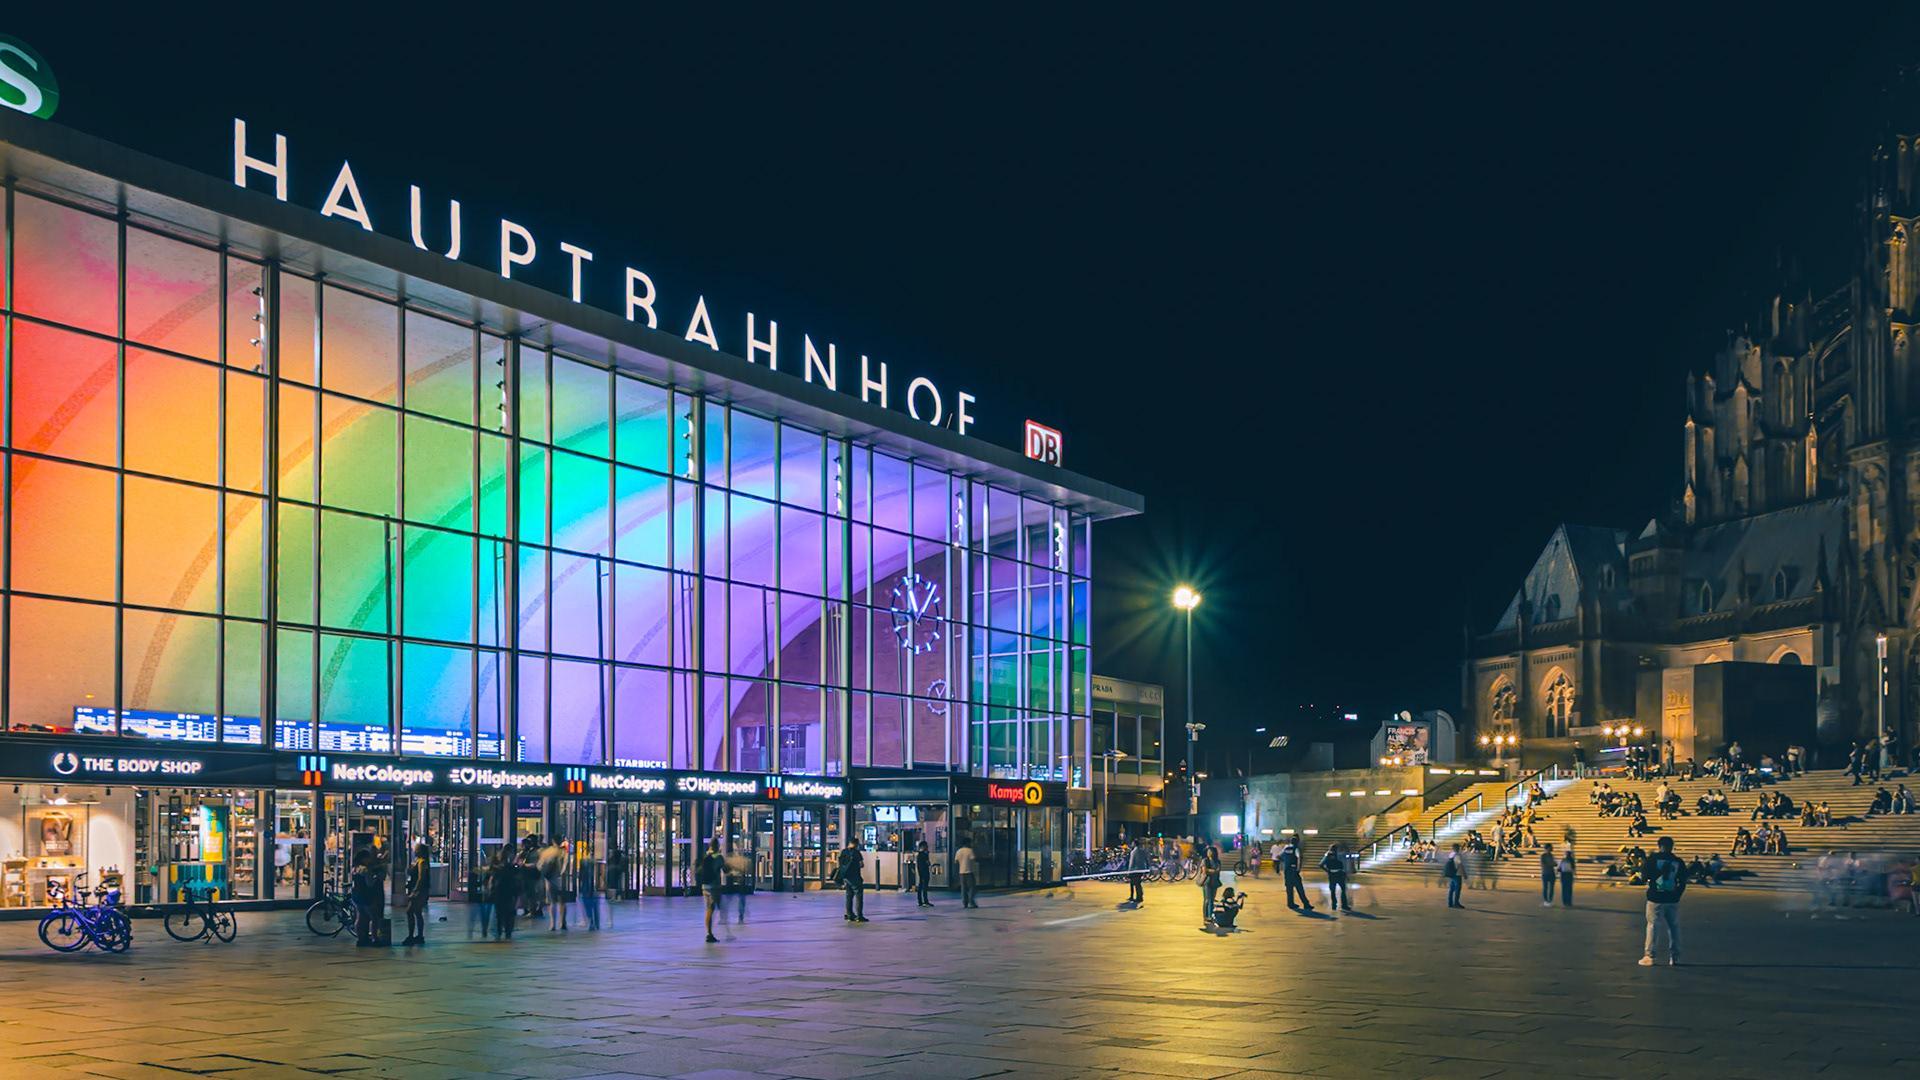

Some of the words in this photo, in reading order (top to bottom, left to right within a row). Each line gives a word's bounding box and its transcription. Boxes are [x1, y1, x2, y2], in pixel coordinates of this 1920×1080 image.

[0, 42, 42, 114] S
[234, 117, 976, 436] HAUPTBAHNHOF
[1030, 428, 1058, 465] DB
[1092, 683, 1113, 693] PRADA
[82, 758, 114, 772] THE
[117, 759, 160, 773] BODY
[161, 760, 202, 775] SHOP
[614, 758, 667, 769] STARBUCKS
[333, 763, 434, 786] NetCologne
[476, 769, 554, 789] Highspeed
[591, 773, 666, 793] NetCologne
[698, 778, 757, 796] Highspeed
[784, 781, 843, 799] NetCologne
[989, 783, 1024, 803] Kamps
